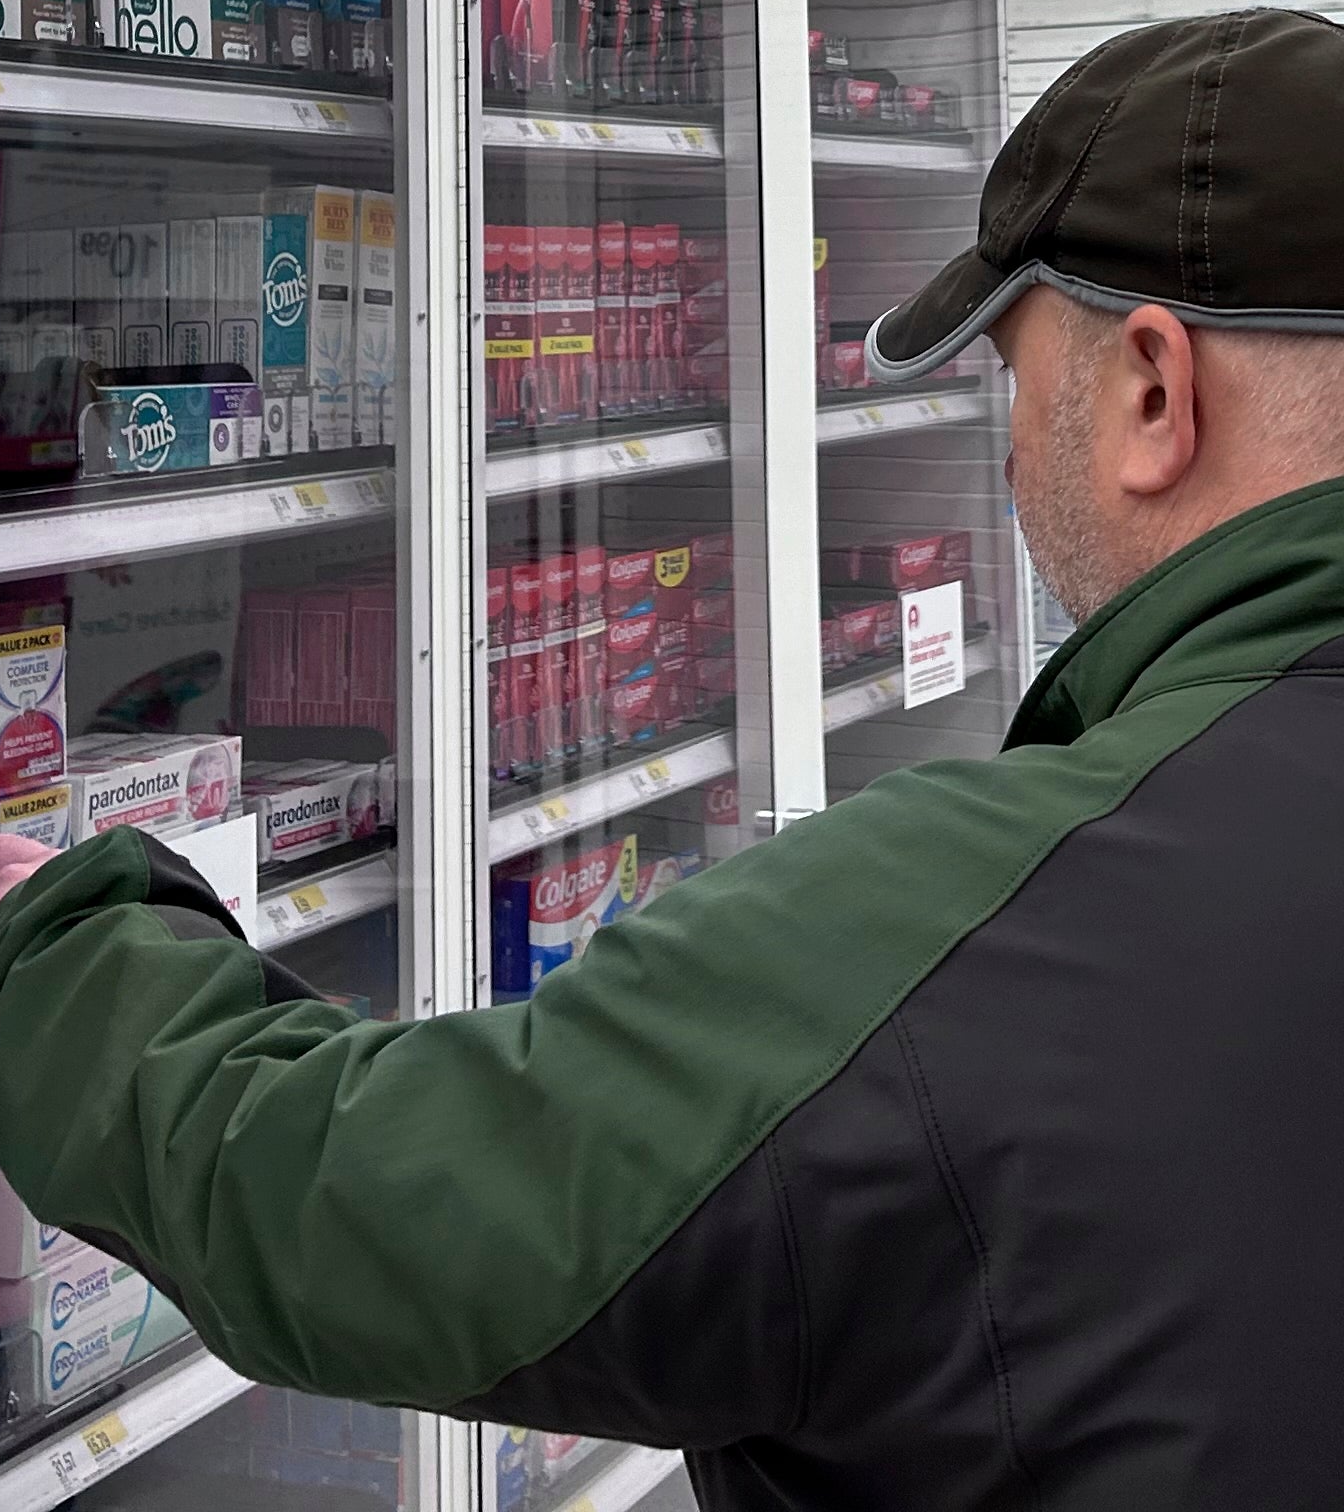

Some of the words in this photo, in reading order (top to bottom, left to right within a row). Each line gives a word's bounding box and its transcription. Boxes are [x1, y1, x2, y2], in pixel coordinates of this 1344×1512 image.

[326, 218, 346, 232] BEES
[263, 265, 307, 314] Tom's
[121, 406, 176, 461] Tom's
[218, 432, 225, 443] 6
[609, 557, 650, 580] Colgate
[22, 637, 28, 649] 2
[28, 634, 51, 647] PACK
[610, 620, 651, 643] Colgate
[7, 660, 49, 679] COMPLETE
[613, 684, 653, 707] Colgate
[3, 803, 30, 818] VALUE
[31, 801, 36, 812] 2
[36, 796, 58, 809] PACK
[89, 771, 179, 820] parodontax
[534, 859, 607, 911] Colgate
[56, 1278, 110, 1313] PRONAMEL
[56, 1335, 109, 1373] PRONAMEL
